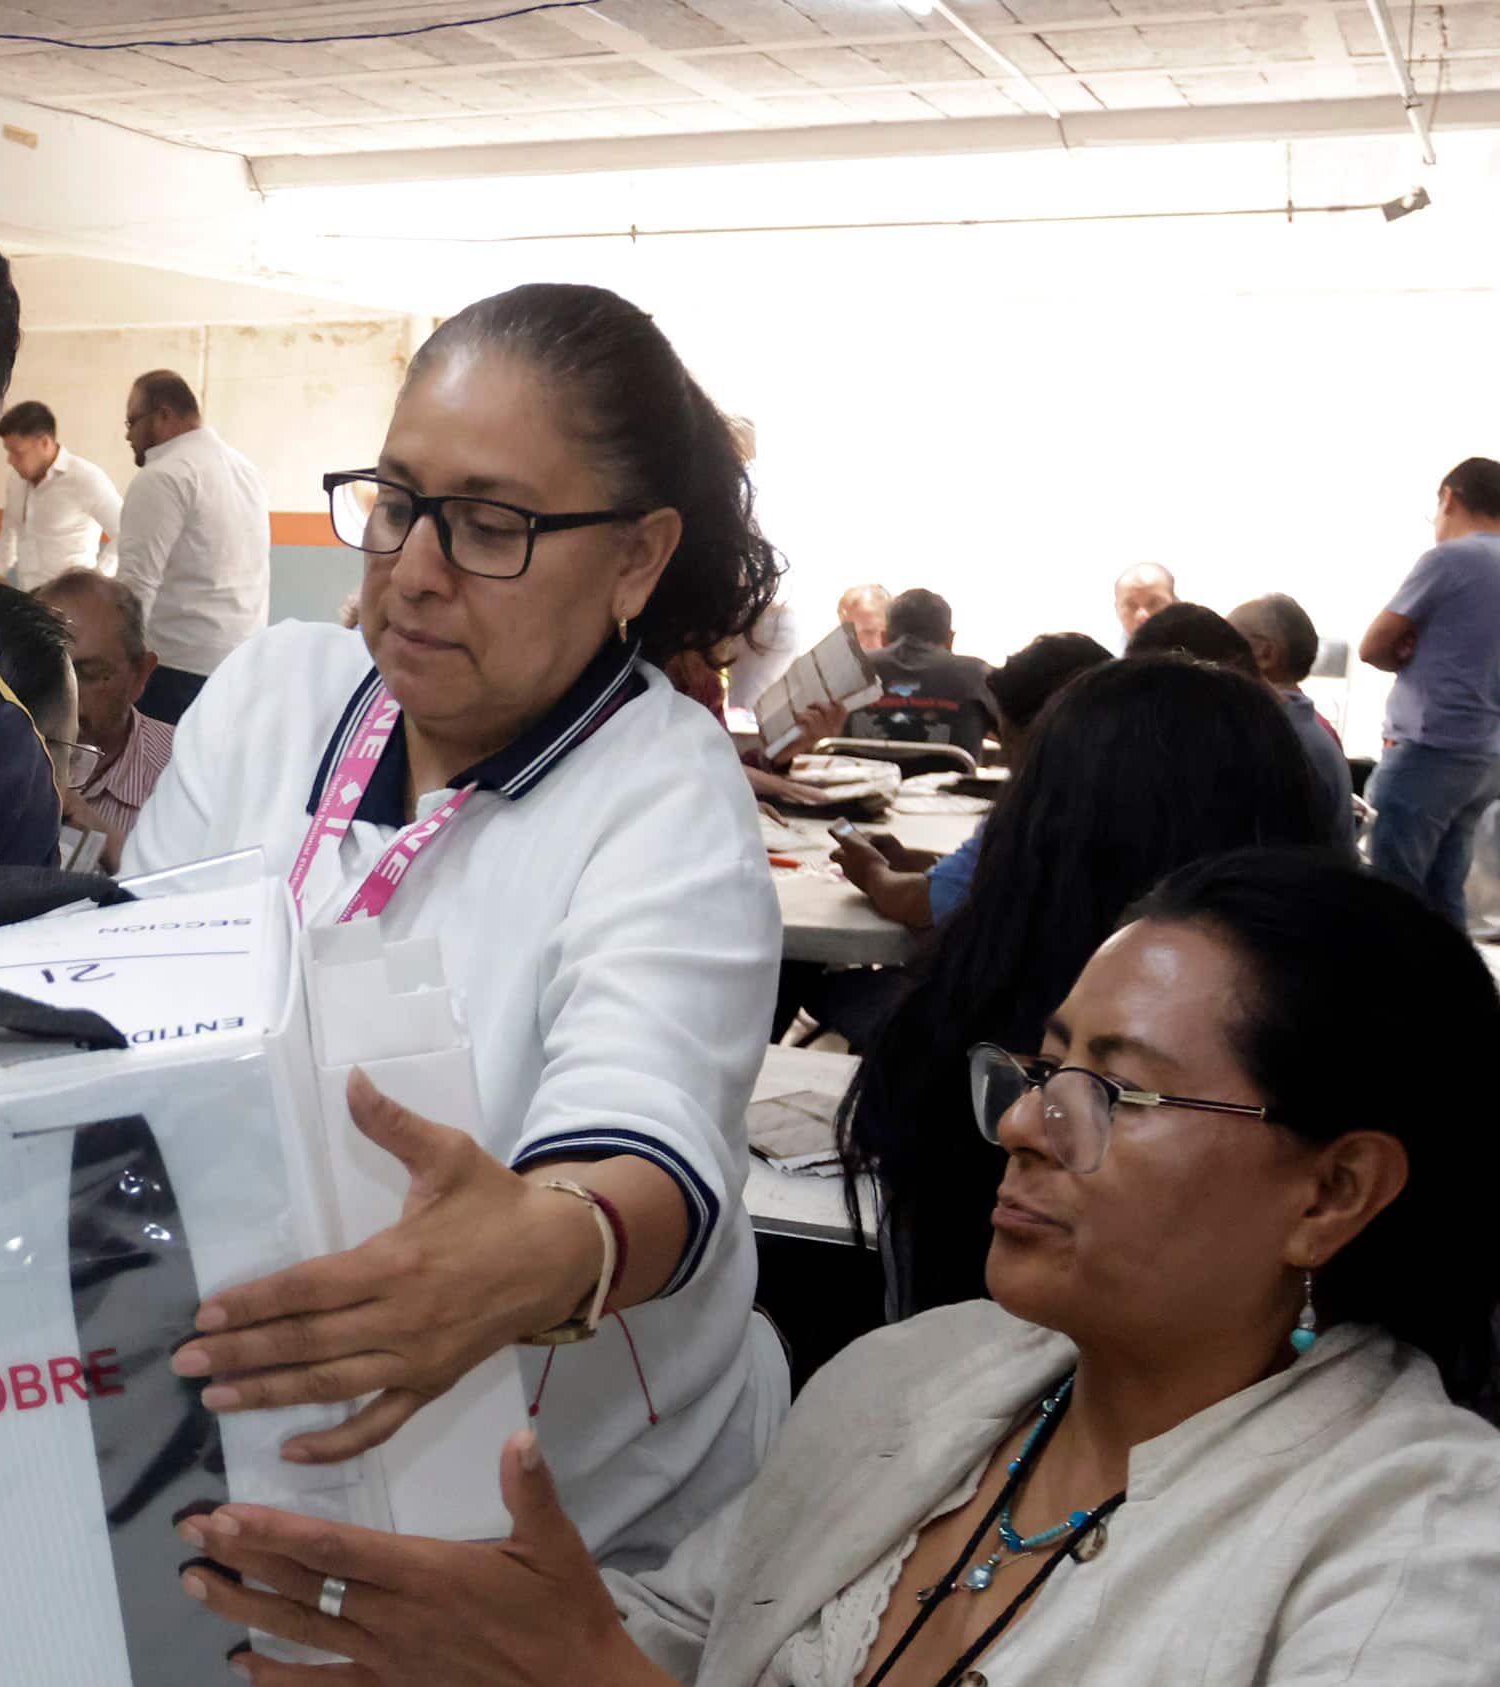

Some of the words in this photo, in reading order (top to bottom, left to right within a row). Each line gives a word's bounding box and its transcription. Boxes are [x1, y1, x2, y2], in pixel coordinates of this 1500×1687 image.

[357, 699, 401, 759] NE
[381, 806, 455, 886] INE
[41, 963, 116, 984] 21
[132, 1016, 245, 1044] ENTID
